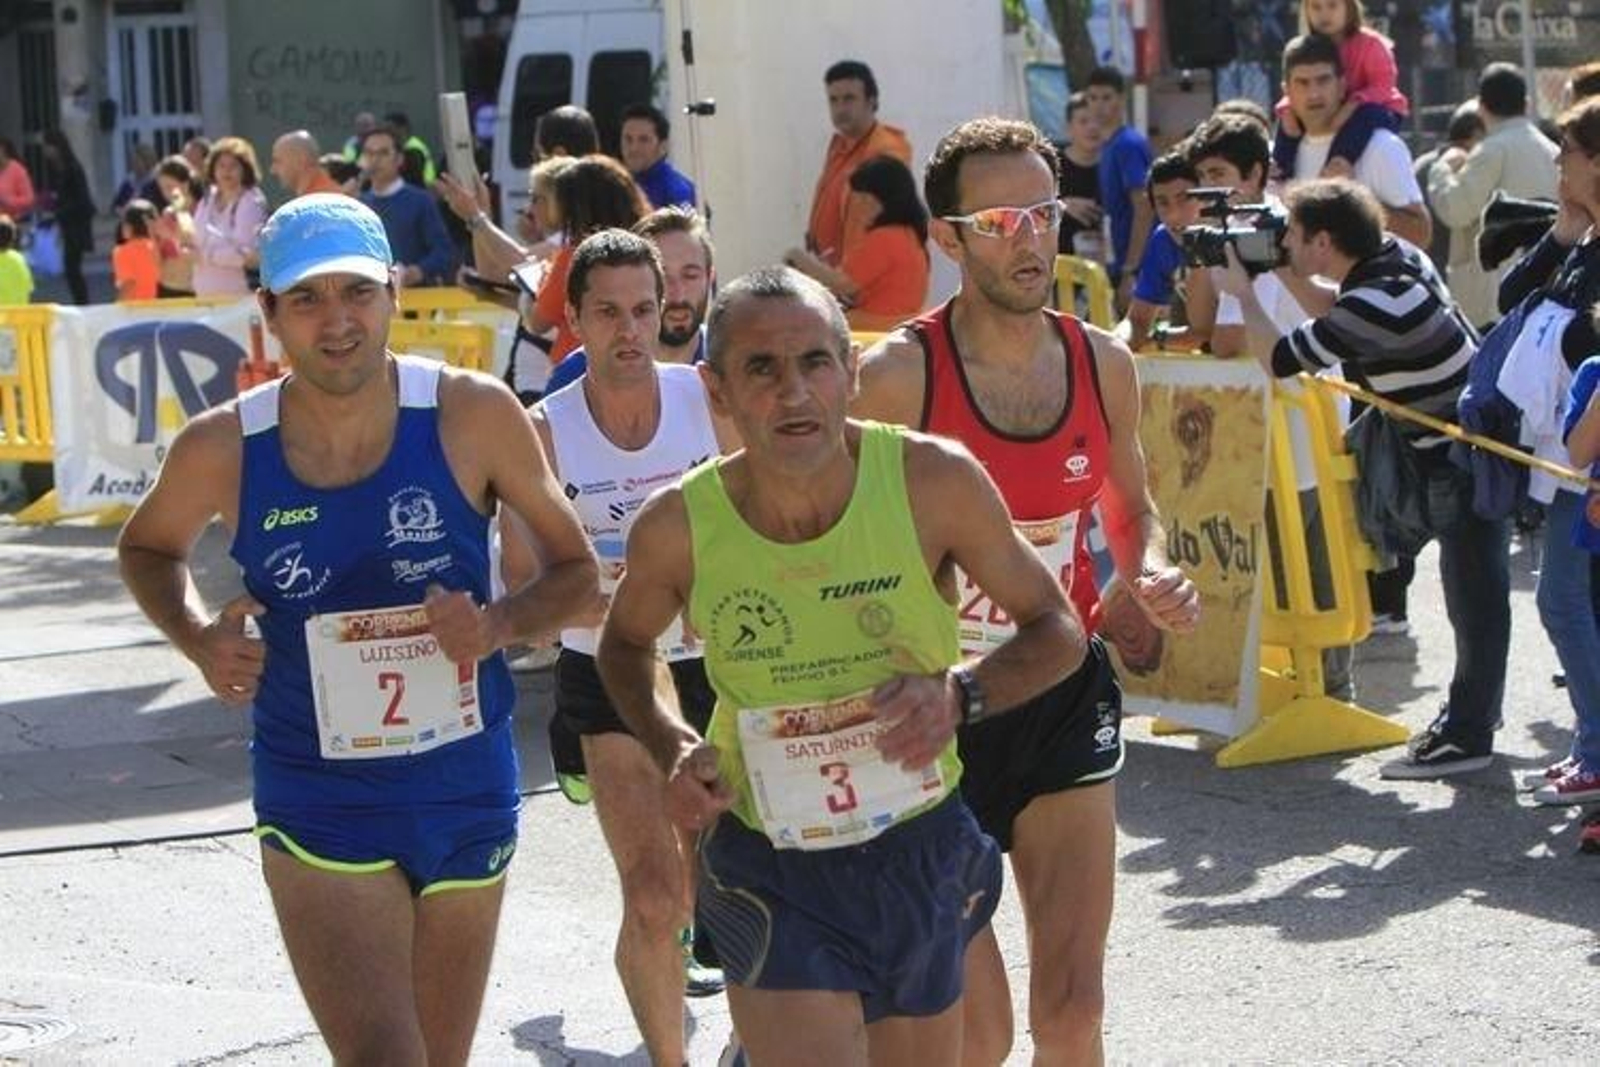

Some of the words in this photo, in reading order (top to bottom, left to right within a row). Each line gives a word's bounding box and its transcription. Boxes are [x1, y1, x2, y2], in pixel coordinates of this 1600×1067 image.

[248, 45, 416, 85] GAMONAL
[88, 471, 158, 496] Acad
[281, 506, 318, 526] asics
[1200, 514, 1257, 579] Val
[819, 574, 902, 602] TURINI
[378, 672, 410, 726] 2
[819, 761, 858, 814] 3
